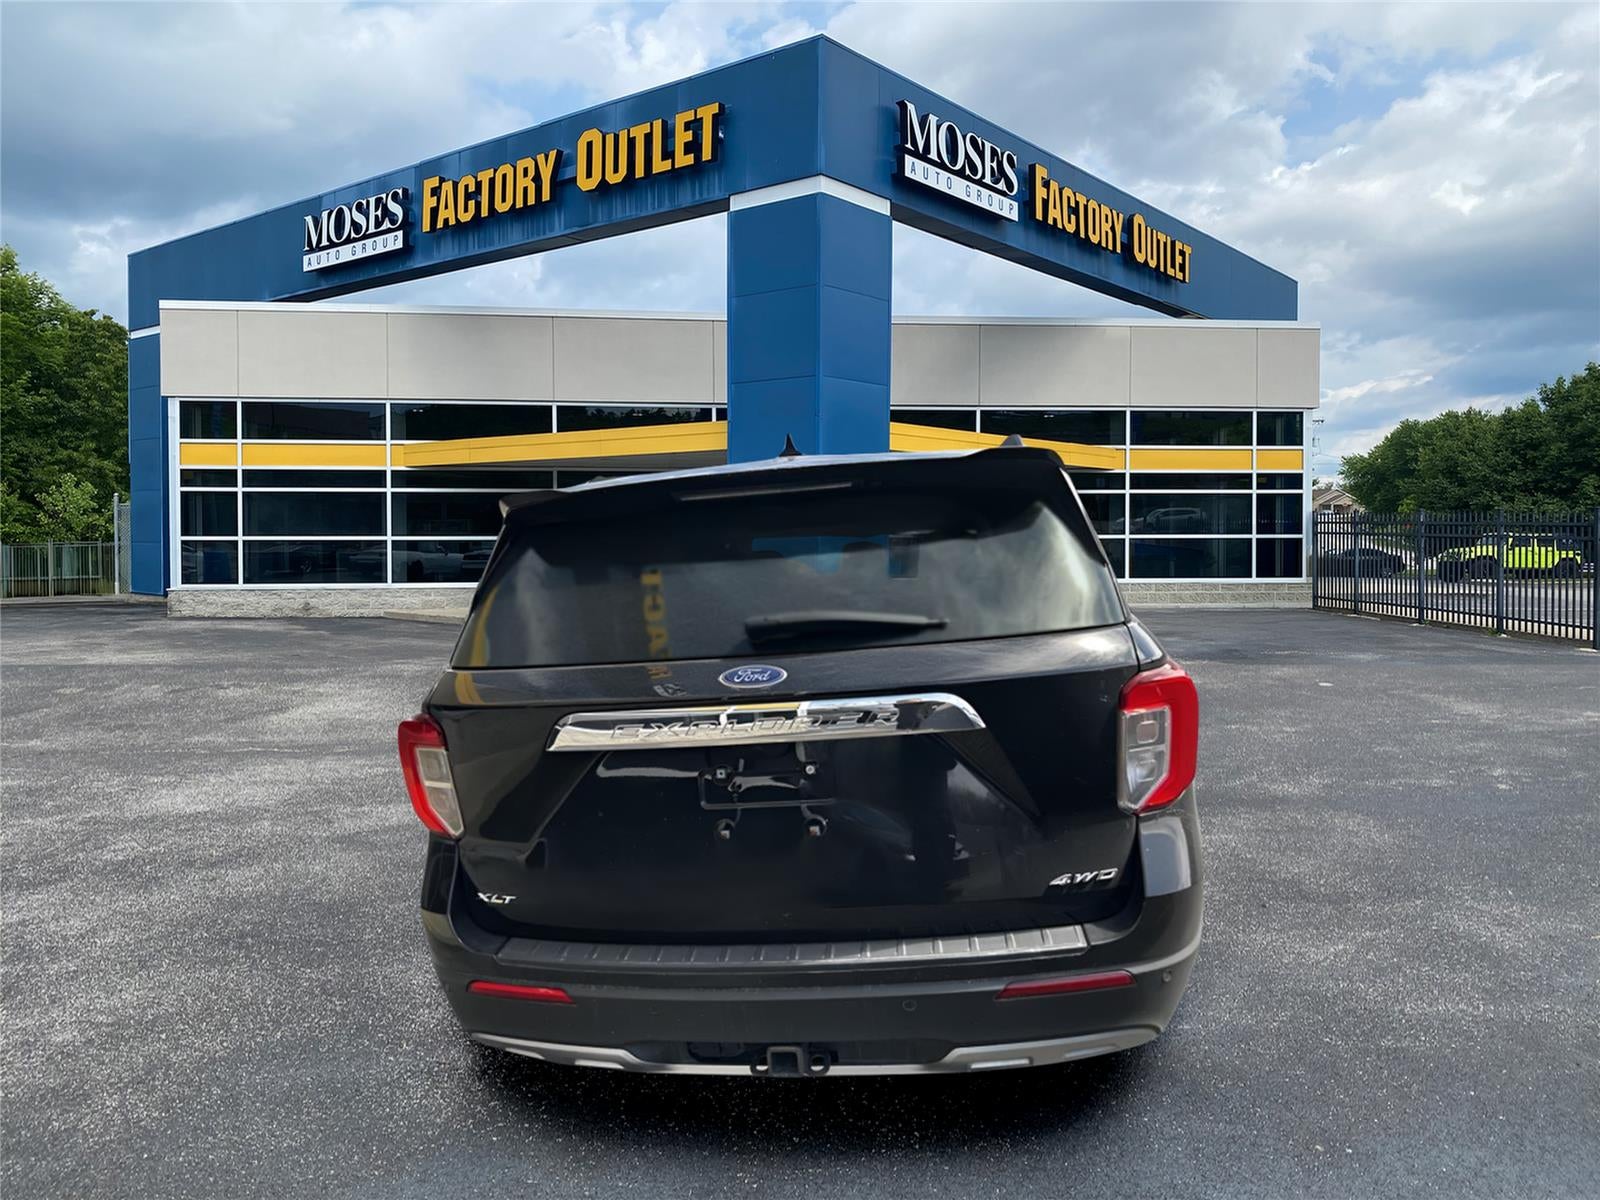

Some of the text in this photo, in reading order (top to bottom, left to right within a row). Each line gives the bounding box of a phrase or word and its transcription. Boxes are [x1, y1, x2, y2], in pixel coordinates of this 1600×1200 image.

[422, 102, 720, 233] FACTORY OUTLET
[904, 100, 1019, 196] MOSES
[910, 161, 1015, 214] AUTO GROUP
[303, 188, 404, 251] MOSES
[1034, 163, 1192, 283] FACTORY OUTLET
[307, 234, 400, 268] AUTO GROUP
[733, 667, 772, 683] Ford
[611, 706, 899, 739] EXPLORER
[477, 892, 517, 904] XLT
[1048, 867, 1119, 886] 4WD
